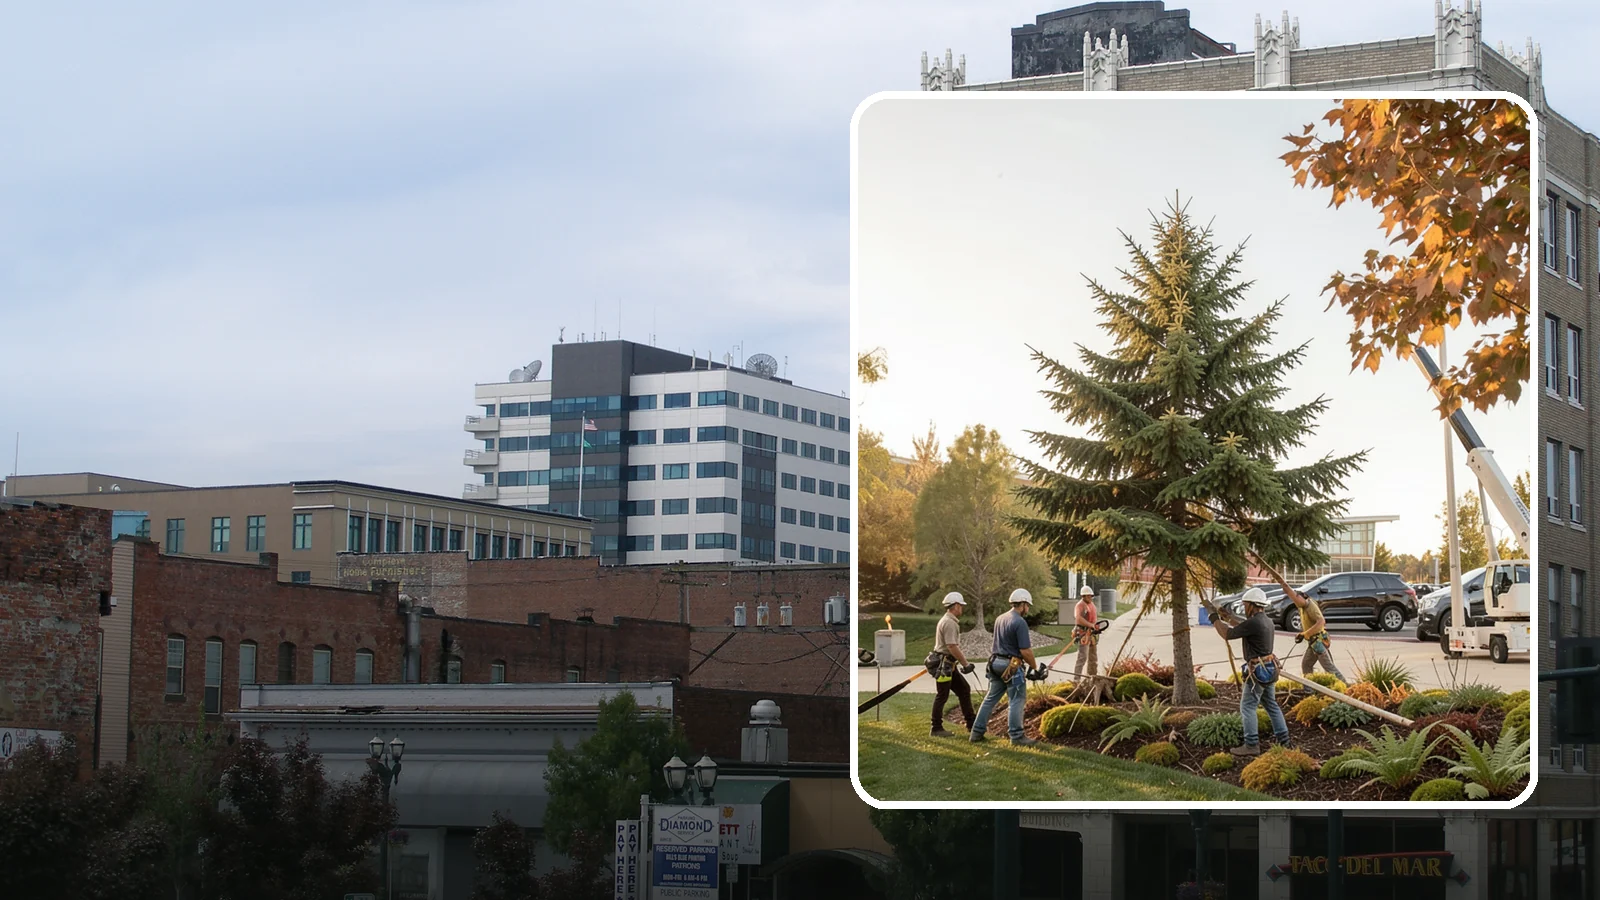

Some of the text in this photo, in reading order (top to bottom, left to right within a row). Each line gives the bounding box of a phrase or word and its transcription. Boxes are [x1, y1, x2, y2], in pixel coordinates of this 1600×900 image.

[660, 818, 713, 833] DIAMOND
[1022, 815, 1070, 828] BUILDING
[656, 845, 716, 854] RESERVED PARKING
[616, 824, 625, 894] PAY HERE
[627, 824, 637, 894] PAY HERE
[721, 851, 739, 862] Soup
[671, 862, 701, 870] PATRONS
[1345, 856, 1385, 875] DEL
[1392, 857, 1443, 877] MAR
[660, 889, 710, 898] PUBLIC PARKING
